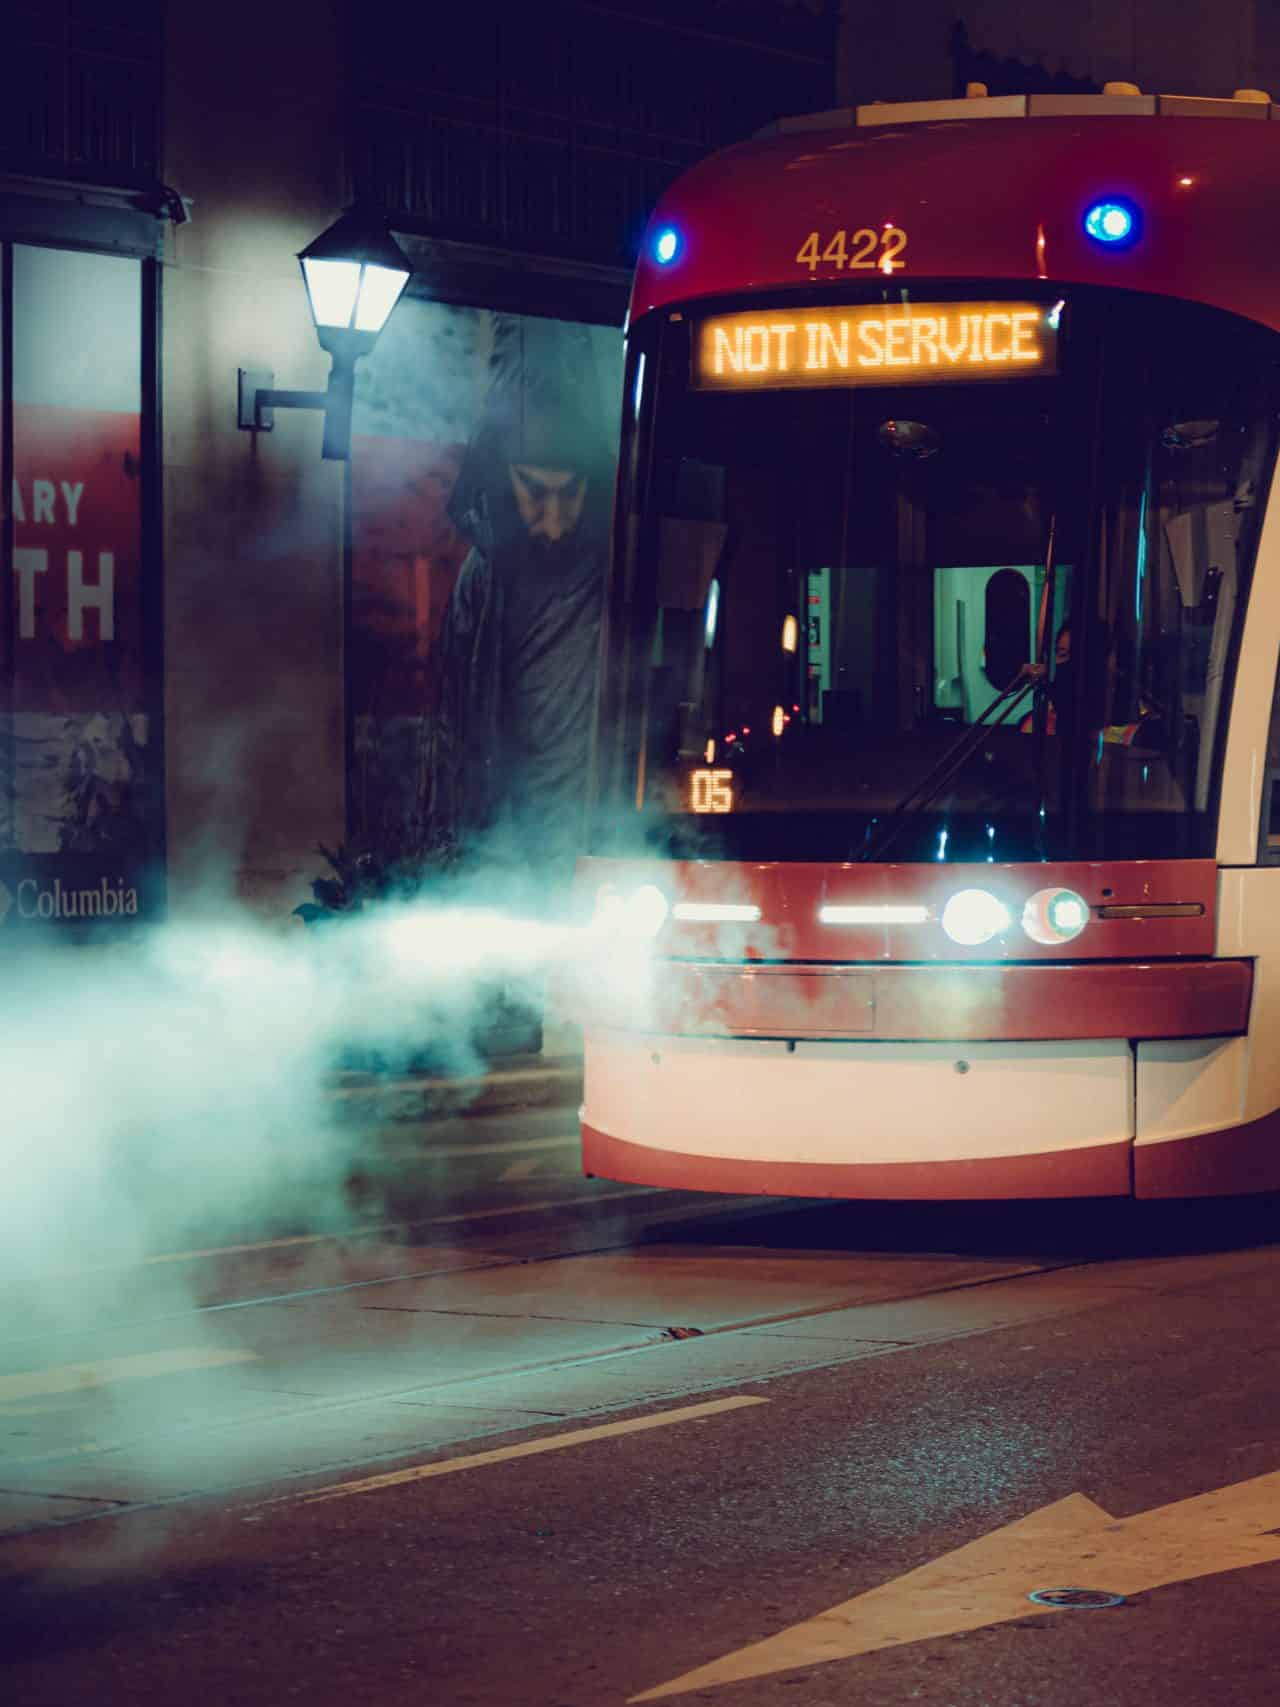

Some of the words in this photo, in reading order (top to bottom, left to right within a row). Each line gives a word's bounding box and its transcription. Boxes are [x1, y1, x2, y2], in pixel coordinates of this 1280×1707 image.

[796, 228, 907, 272] 4422
[714, 324, 796, 374] NOT
[805, 320, 848, 369] IN
[857, 312, 1039, 367] SERVICE
[12, 547, 115, 641] TH
[692, 770, 733, 813] 05
[17, 876, 138, 918] Columbia
